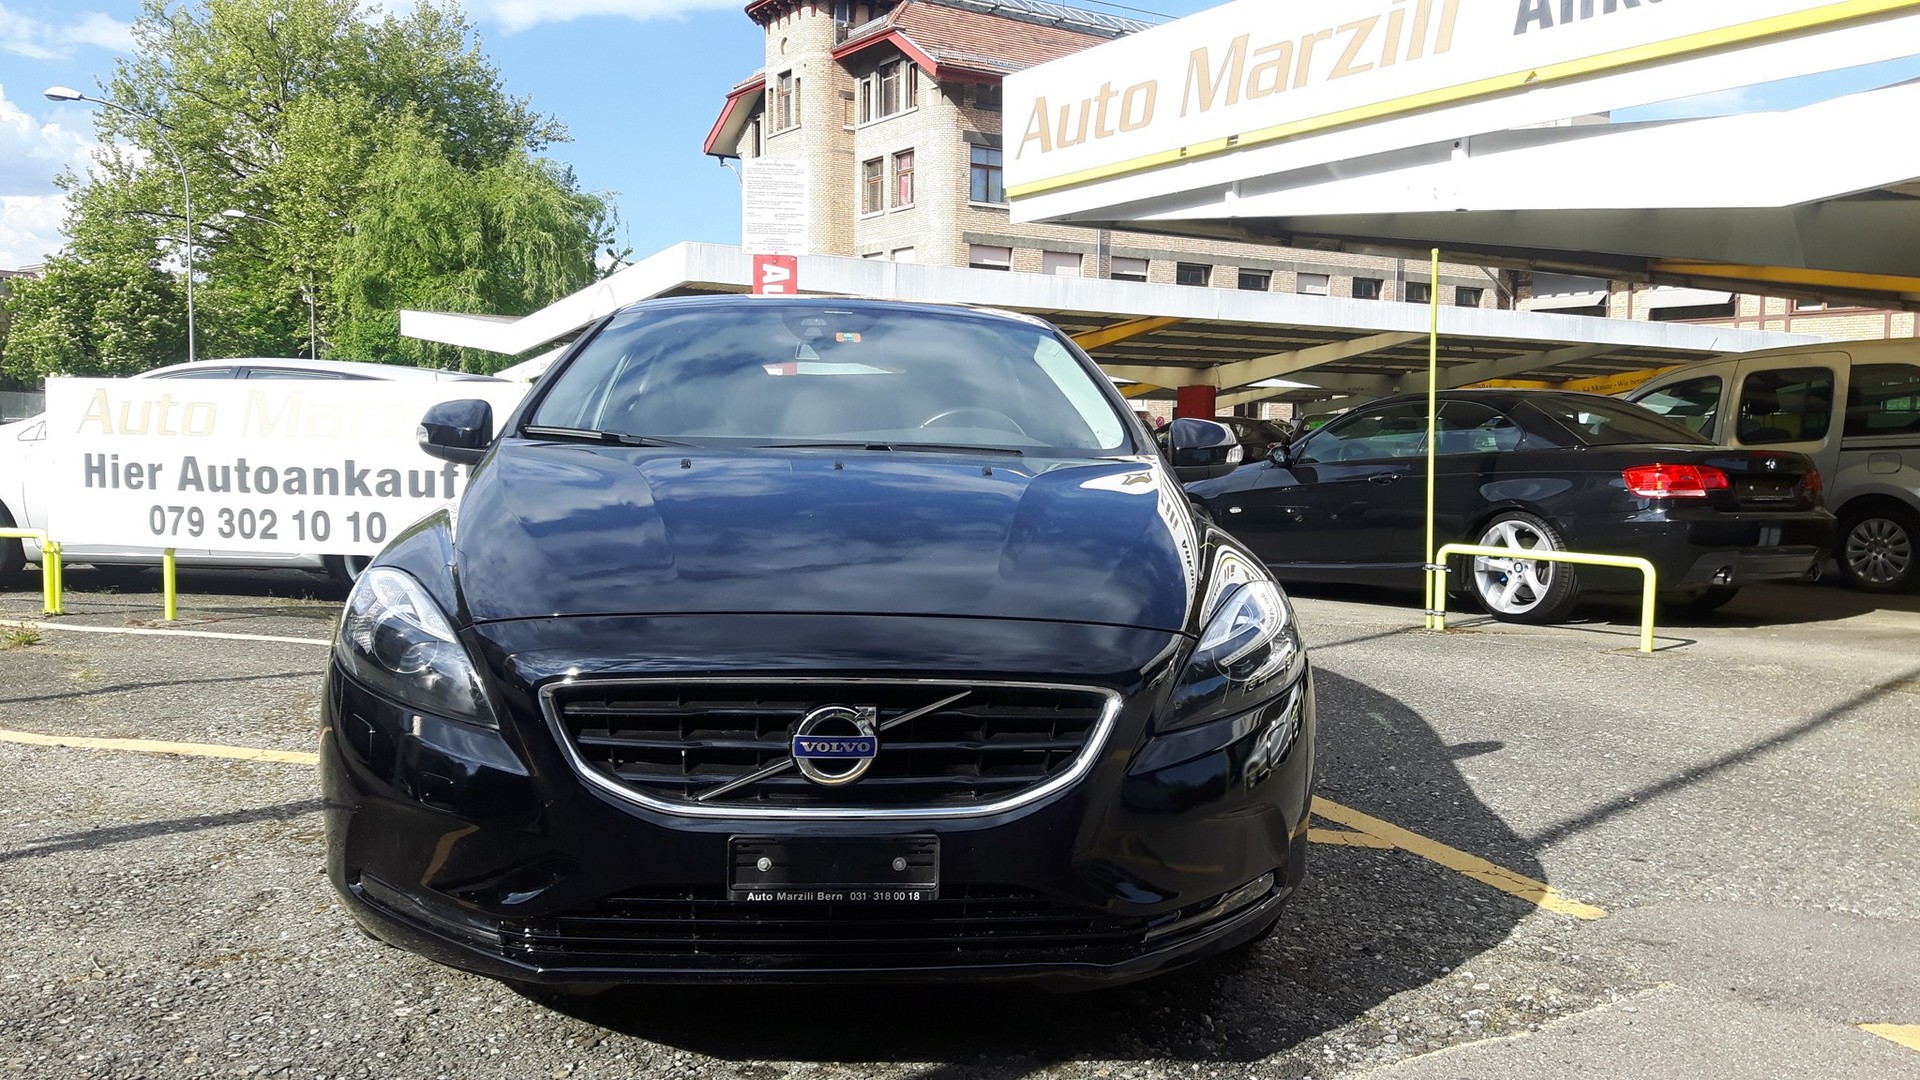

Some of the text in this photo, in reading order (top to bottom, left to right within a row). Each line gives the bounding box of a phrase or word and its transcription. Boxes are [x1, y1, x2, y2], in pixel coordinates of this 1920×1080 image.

[1015, 79, 1158, 160] Auto
[76, 388, 217, 437] Auto
[84, 453, 163, 491] Hier
[149, 504, 387, 543] 079 302 10 10
[800, 742, 870, 752] VOLVO
[747, 892, 773, 901] Auto
[776, 892, 813, 901] Marzili
[817, 892, 843, 901] Bern
[893, 892, 906, 901] 00
[908, 892, 920, 901] 18
